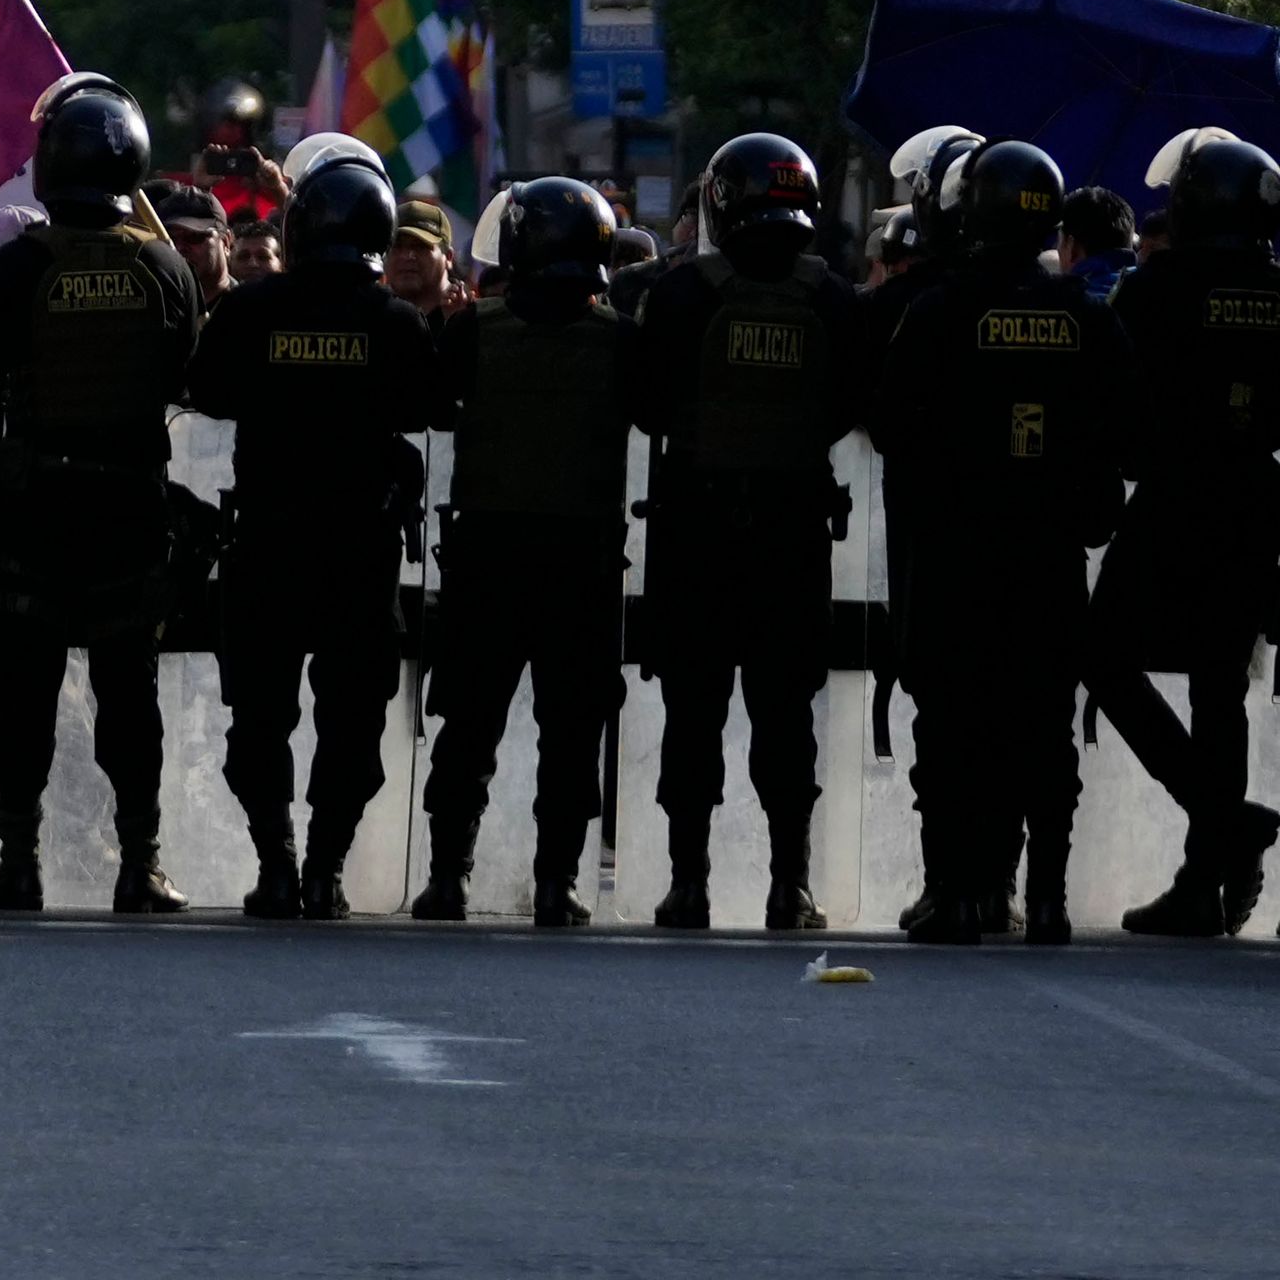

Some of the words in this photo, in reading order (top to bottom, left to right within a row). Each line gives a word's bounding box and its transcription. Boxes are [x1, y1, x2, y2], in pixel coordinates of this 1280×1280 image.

[1020, 191, 1050, 211] USE
[61, 274, 134, 300] POLICIA
[988, 316, 1072, 345] POLICIA
[273, 334, 364, 361] POLICIA
[730, 323, 801, 366] POLICIA
